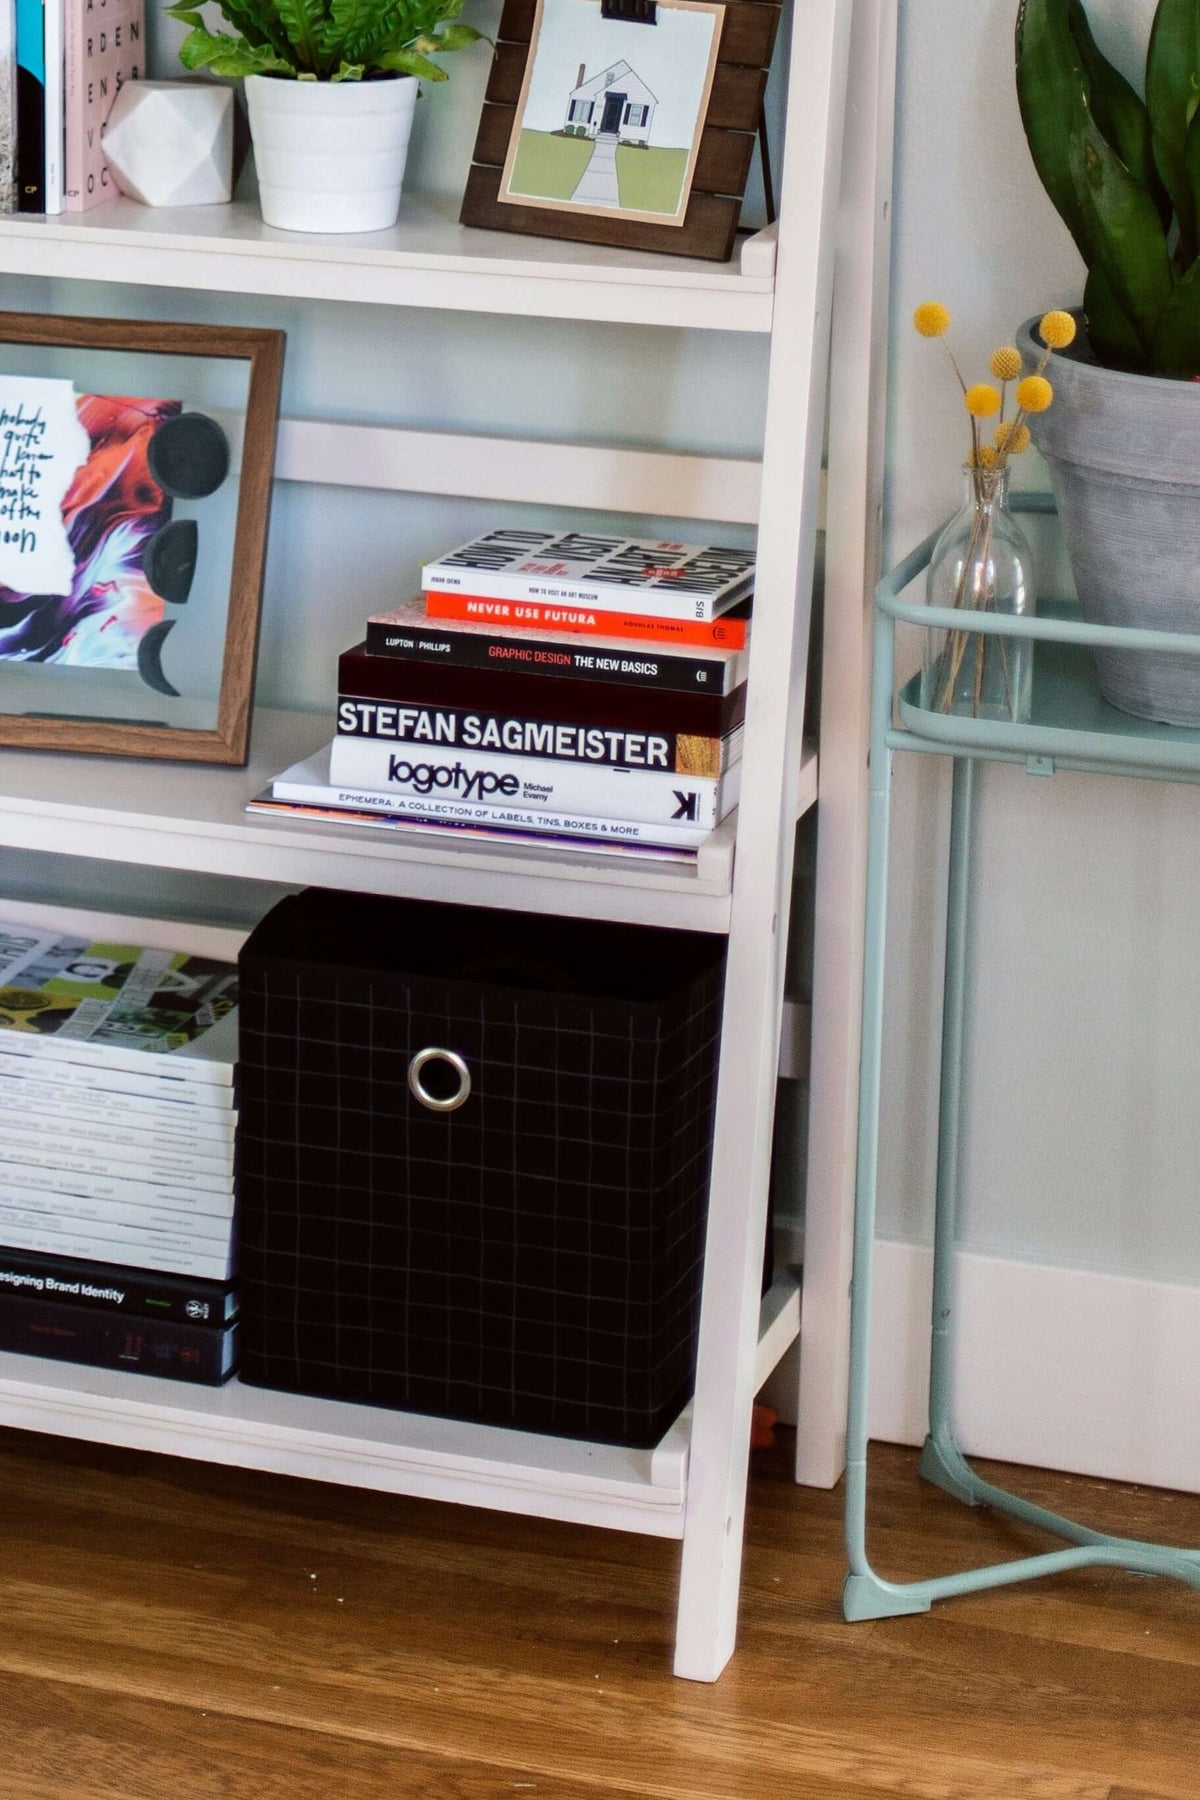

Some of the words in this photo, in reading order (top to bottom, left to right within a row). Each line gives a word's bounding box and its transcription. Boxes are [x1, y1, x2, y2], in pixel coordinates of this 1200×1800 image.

[4, 431, 40, 457] quite
[28, 463, 41, 485] to
[0, 498, 18, 520] of
[18, 501, 40, 520] the
[481, 530, 555, 545] TO
[532, 533, 626, 562] VISIT
[439, 542, 531, 571] HOW
[606, 545, 689, 570] ART
[582, 566, 652, 587] AN
[649, 546, 756, 595] MUSEUM
[548, 588, 559, 596] VISIT
[568, 590, 577, 598] ART
[578, 591, 598, 600] MUSEUM
[467, 601, 510, 618] NEVER
[516, 606, 540, 619] USE
[544, 608, 596, 625] FUTURA
[696, 601, 704, 618] BIS
[623, 620, 654, 630] DOUGLAS
[656, 623, 684, 633] THOMAS
[385, 638, 414, 649] LUPTON
[418, 640, 450, 652] PHILLIPS
[488, 645, 532, 662] GRAPHIC
[534, 649, 571, 666] DESIGN
[574, 654, 593, 668] THE
[596, 657, 619, 671] NEW
[620, 659, 658, 676] BASICS
[338, 702, 456, 743] STEFAN
[462, 715, 669, 767] SAGMEISTER
[388, 754, 520, 800] logotype
[523, 782, 553, 793] Michael
[523, 790, 548, 801] Evamy
[408, 802, 472, 817] COLLECTION
[475, 810, 489, 818] OF
[491, 811, 535, 826] LABELS,
[537, 816, 561, 828] TINS,
[564, 820, 598, 832] BOXES
[601, 824, 608, 832] &
[610, 825, 639, 836] MORE
[46, 1277, 80, 1294] Brand
[81, 1280, 125, 1303] Identity
